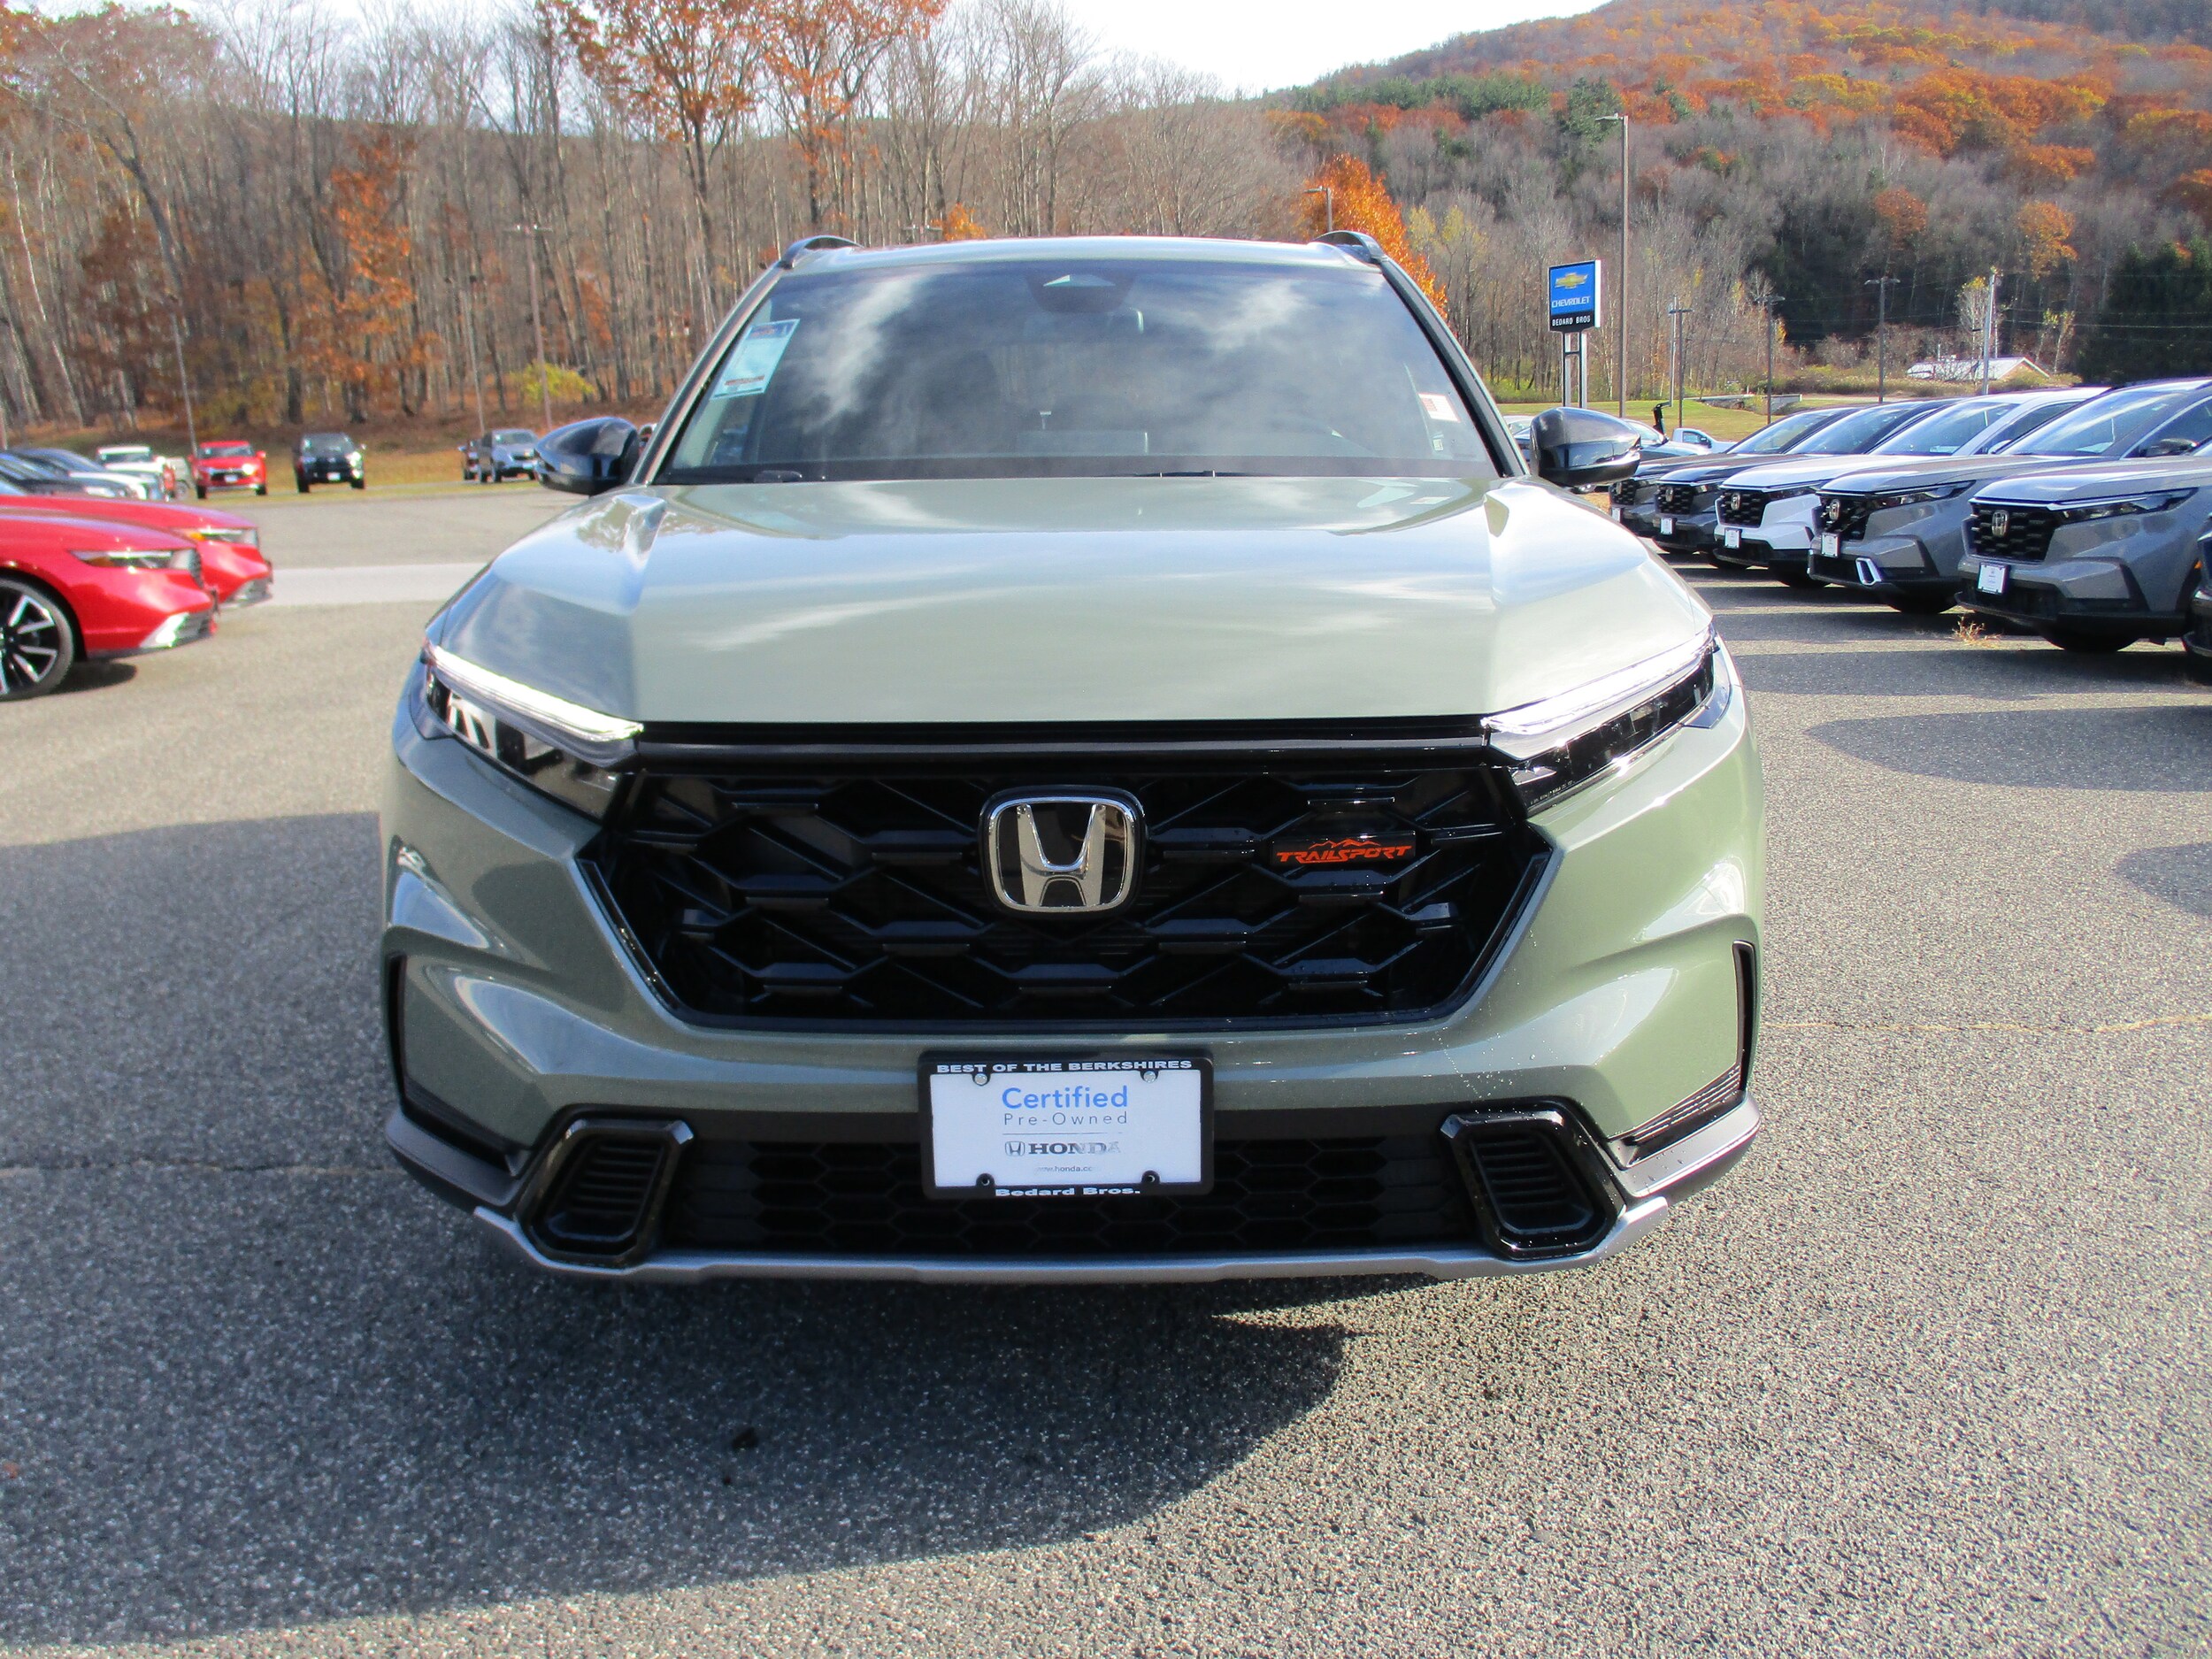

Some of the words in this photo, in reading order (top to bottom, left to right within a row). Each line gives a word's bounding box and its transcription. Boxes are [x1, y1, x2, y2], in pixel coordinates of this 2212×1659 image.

[1551, 296, 1590, 308] CHEVROLET
[1552, 318, 1573, 326] BEDARD
[1576, 315, 1591, 324] BROS
[1277, 845, 1413, 864] TRAILSPORT
[936, 1064, 987, 1073] BEST
[992, 1064, 1018, 1072] OF
[1024, 1063, 1063, 1071] THE
[1068, 1060, 1193, 1071] BERKSHIRES
[1002, 1085, 1128, 1109] Certified
[1003, 1111, 1128, 1126] Pre-Owned
[1028, 1141, 1122, 1155] HONDA
[995, 1187, 1075, 1197] Bedard
[1083, 1187, 1141, 1195] Bros.
